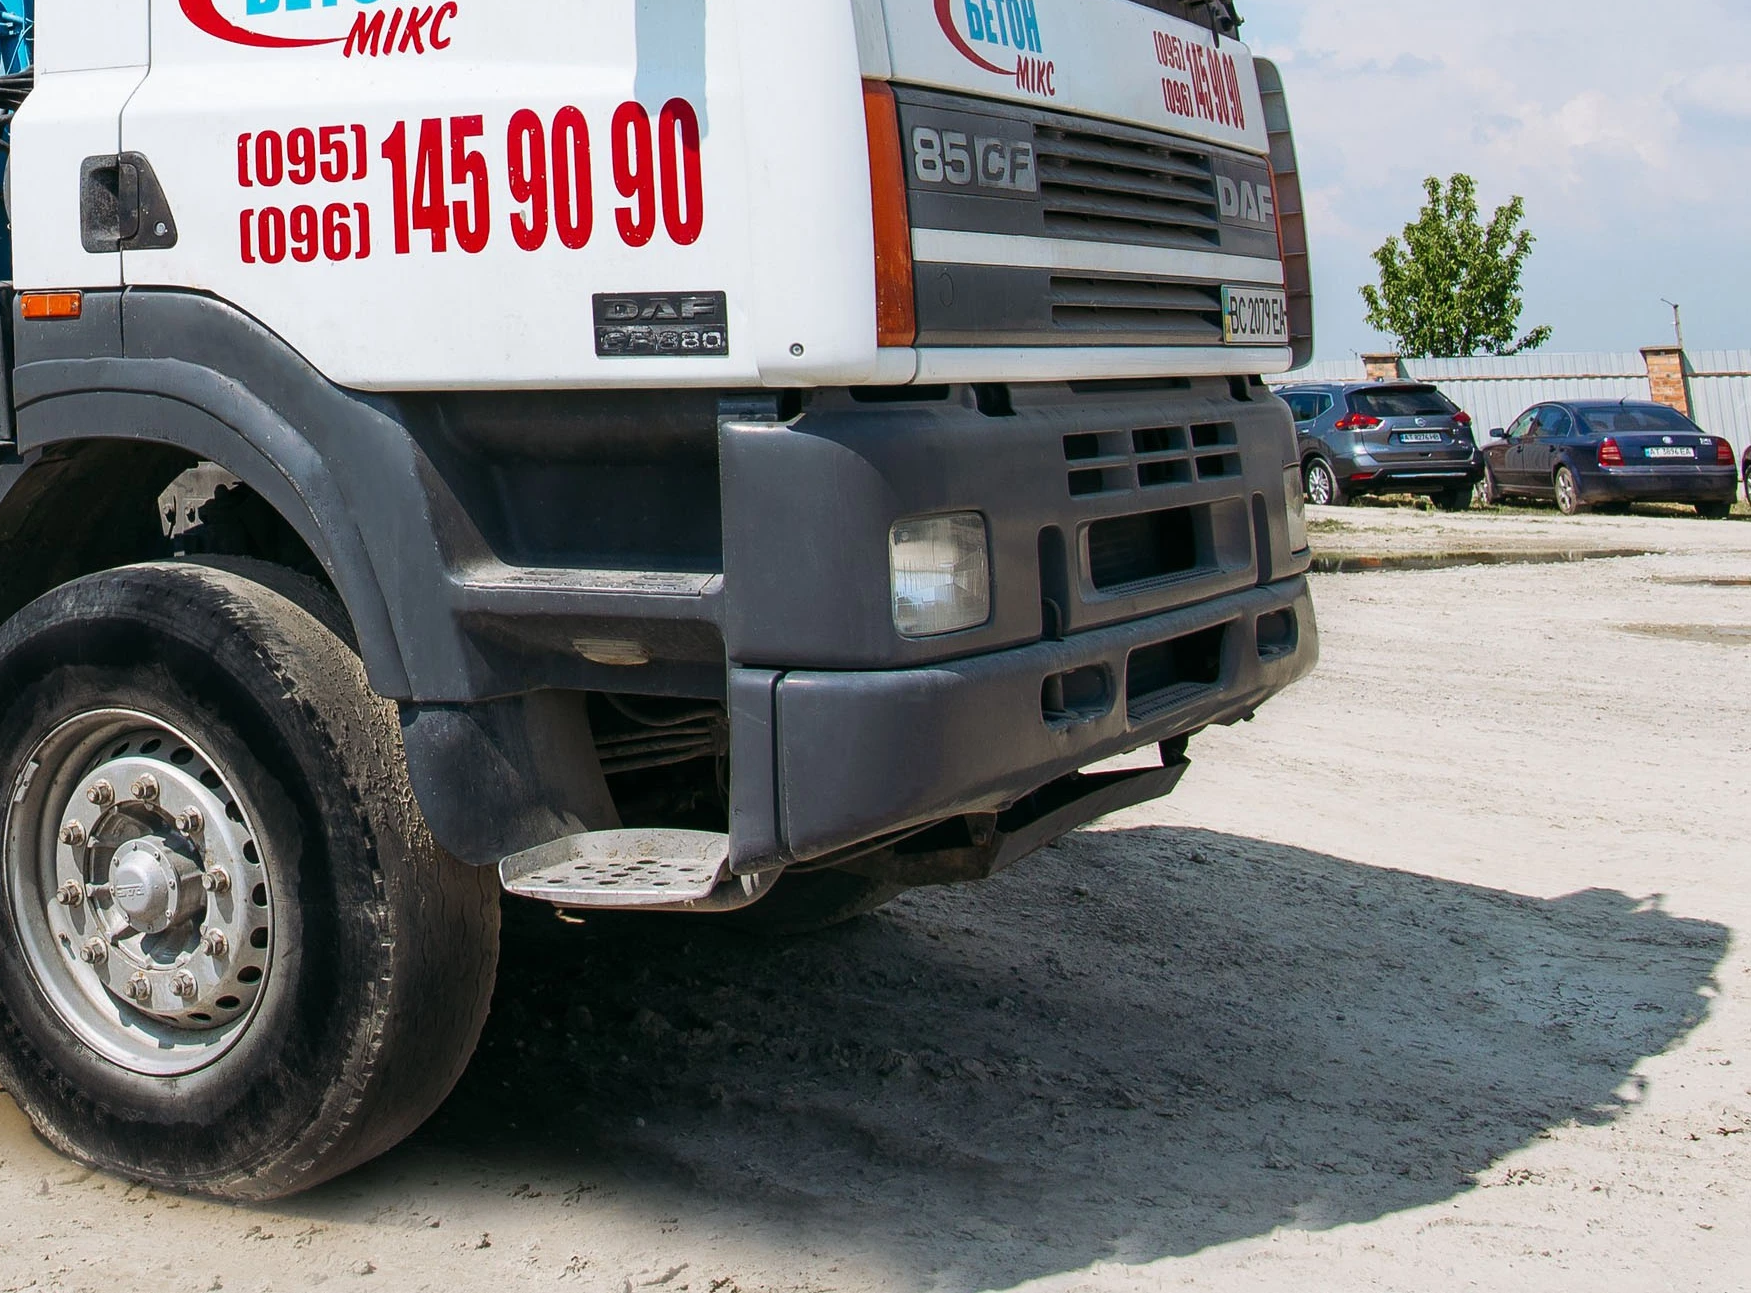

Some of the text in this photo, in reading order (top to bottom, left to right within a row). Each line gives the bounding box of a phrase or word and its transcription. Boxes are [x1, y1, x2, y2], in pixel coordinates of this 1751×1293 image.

[342, 0, 459, 59] МІКС
[1015, 53, 1056, 97] МІКС
[1185, 40, 1215, 123] 145
[1206, 46, 1230, 127] 90
[1221, 51, 1245, 131] 90
[237, 96, 705, 255] (095) 145 90 90
[1215, 174, 1275, 224] DAF
[239, 201, 371, 265] (096)
[602, 296, 716, 322] DAF
[1248, 297, 1271, 335] 2079
